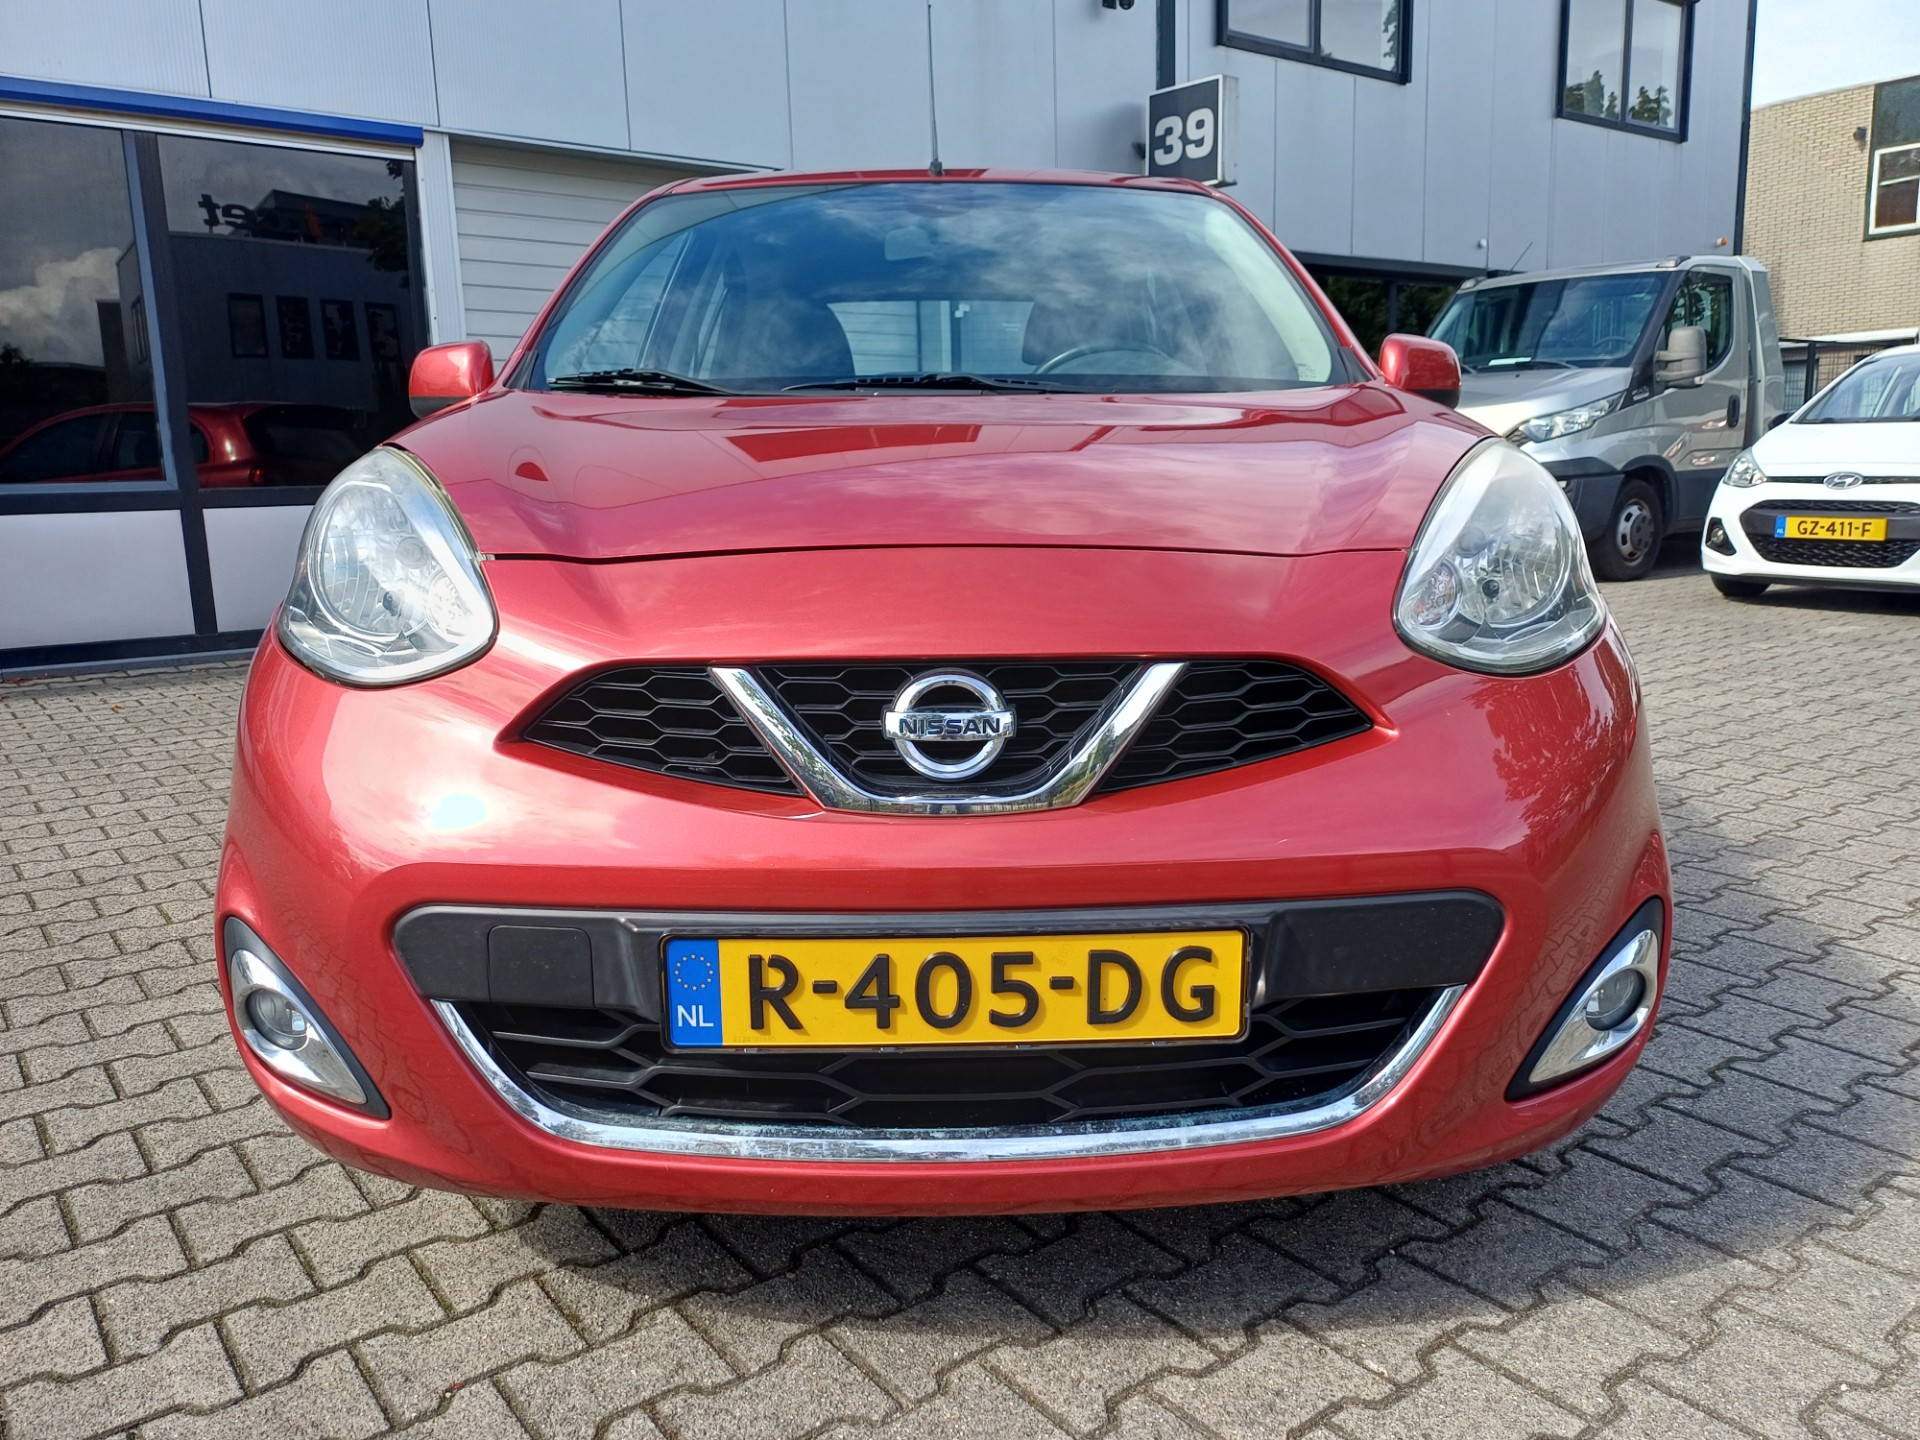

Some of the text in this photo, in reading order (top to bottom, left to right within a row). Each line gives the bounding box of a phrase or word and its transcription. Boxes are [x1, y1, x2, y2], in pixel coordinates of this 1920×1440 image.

[1153, 107, 1215, 166] 39
[1797, 520, 1873, 537] GZ-411-F
[899, 717, 1001, 735] NISSAN
[747, 945, 1216, 1031] R-405-DG
[676, 1004, 715, 1028] NL
